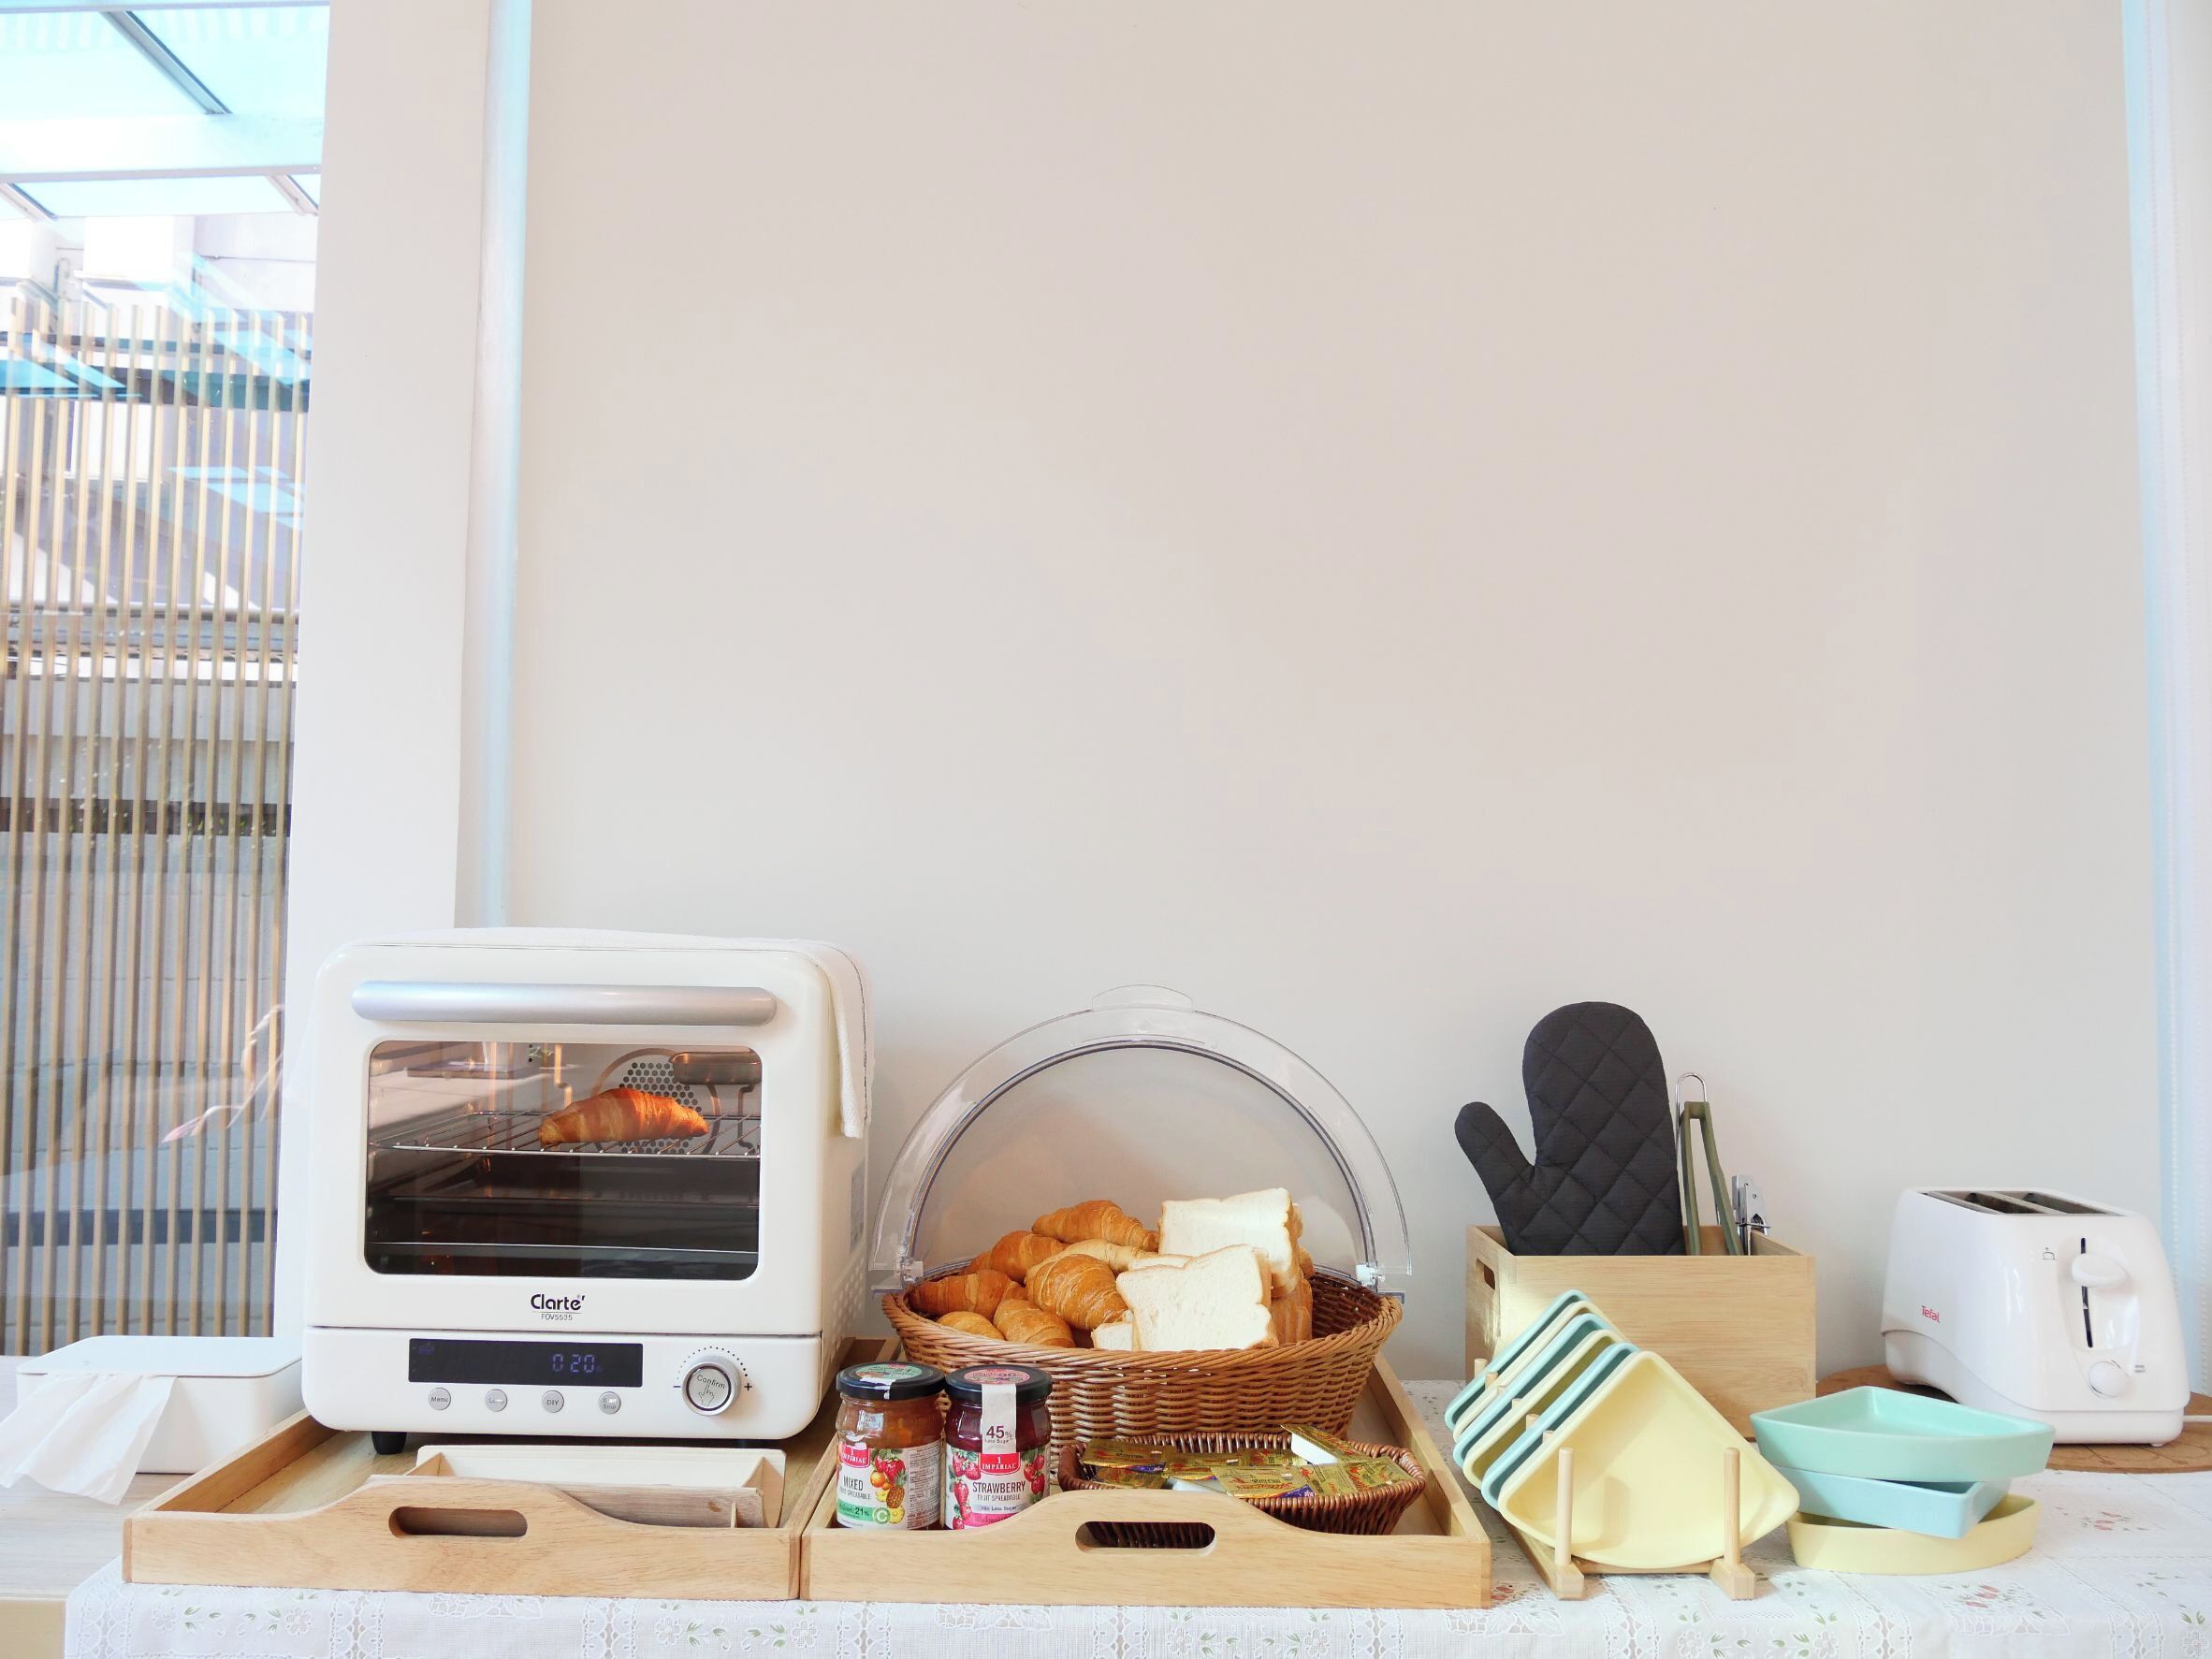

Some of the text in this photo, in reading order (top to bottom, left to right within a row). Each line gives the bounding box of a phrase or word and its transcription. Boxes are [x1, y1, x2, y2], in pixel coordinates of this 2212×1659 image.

[541, 1313, 573, 1321] FOV5535
[1921, 1305, 1940, 1323] Tefal
[696, 1374, 726, 1390] Confirm
[997, 1456, 1002, 1464] 1
[982, 1463, 1016, 1471] IMPERIAL
[843, 1476, 864, 1492] MIXED
[972, 1481, 1026, 1494] STRAWBERRY
